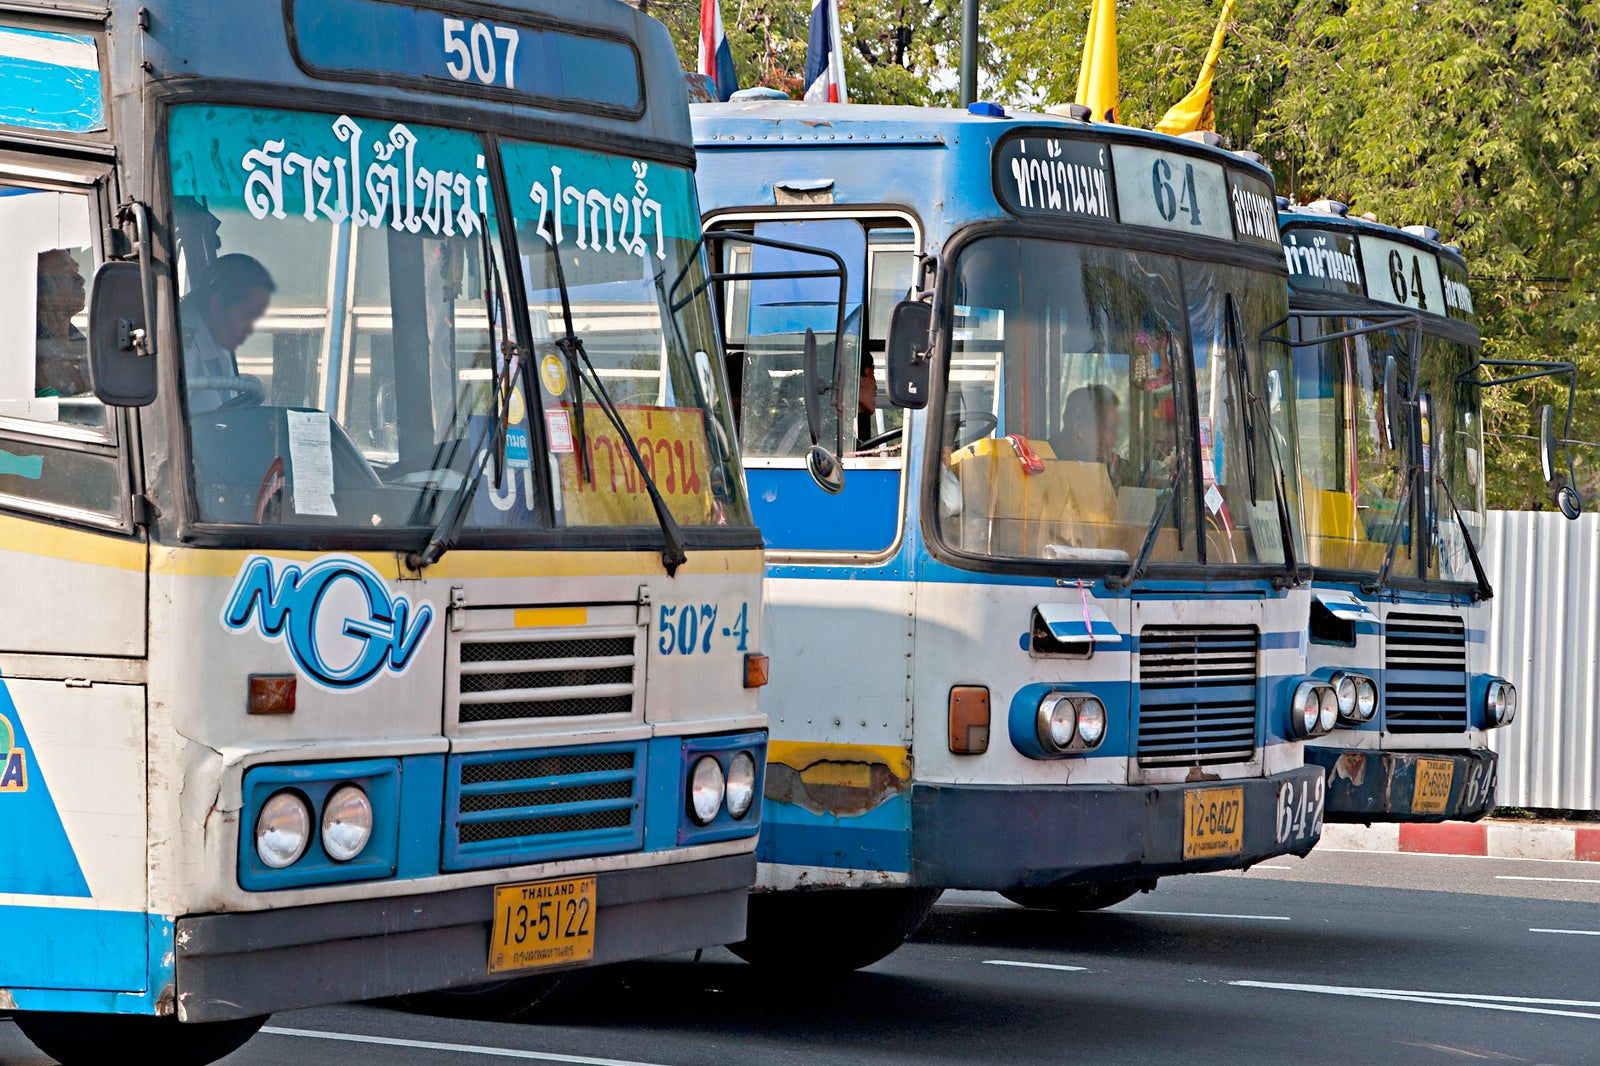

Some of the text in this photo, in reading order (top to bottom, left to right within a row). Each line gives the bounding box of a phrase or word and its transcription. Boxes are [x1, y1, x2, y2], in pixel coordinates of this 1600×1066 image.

[443, 17, 520, 89] 507
[242, 114, 667, 261] สายใต้ใหม่ ปากน้ำ
[1152, 158, 1202, 226] 64
[1388, 249, 1428, 311] 64
[225, 555, 434, 690] NGV
[658, 601, 750, 656] 507-4
[504, 896, 590, 946] 13-5122
[521, 883, 575, 901] THAILAND
